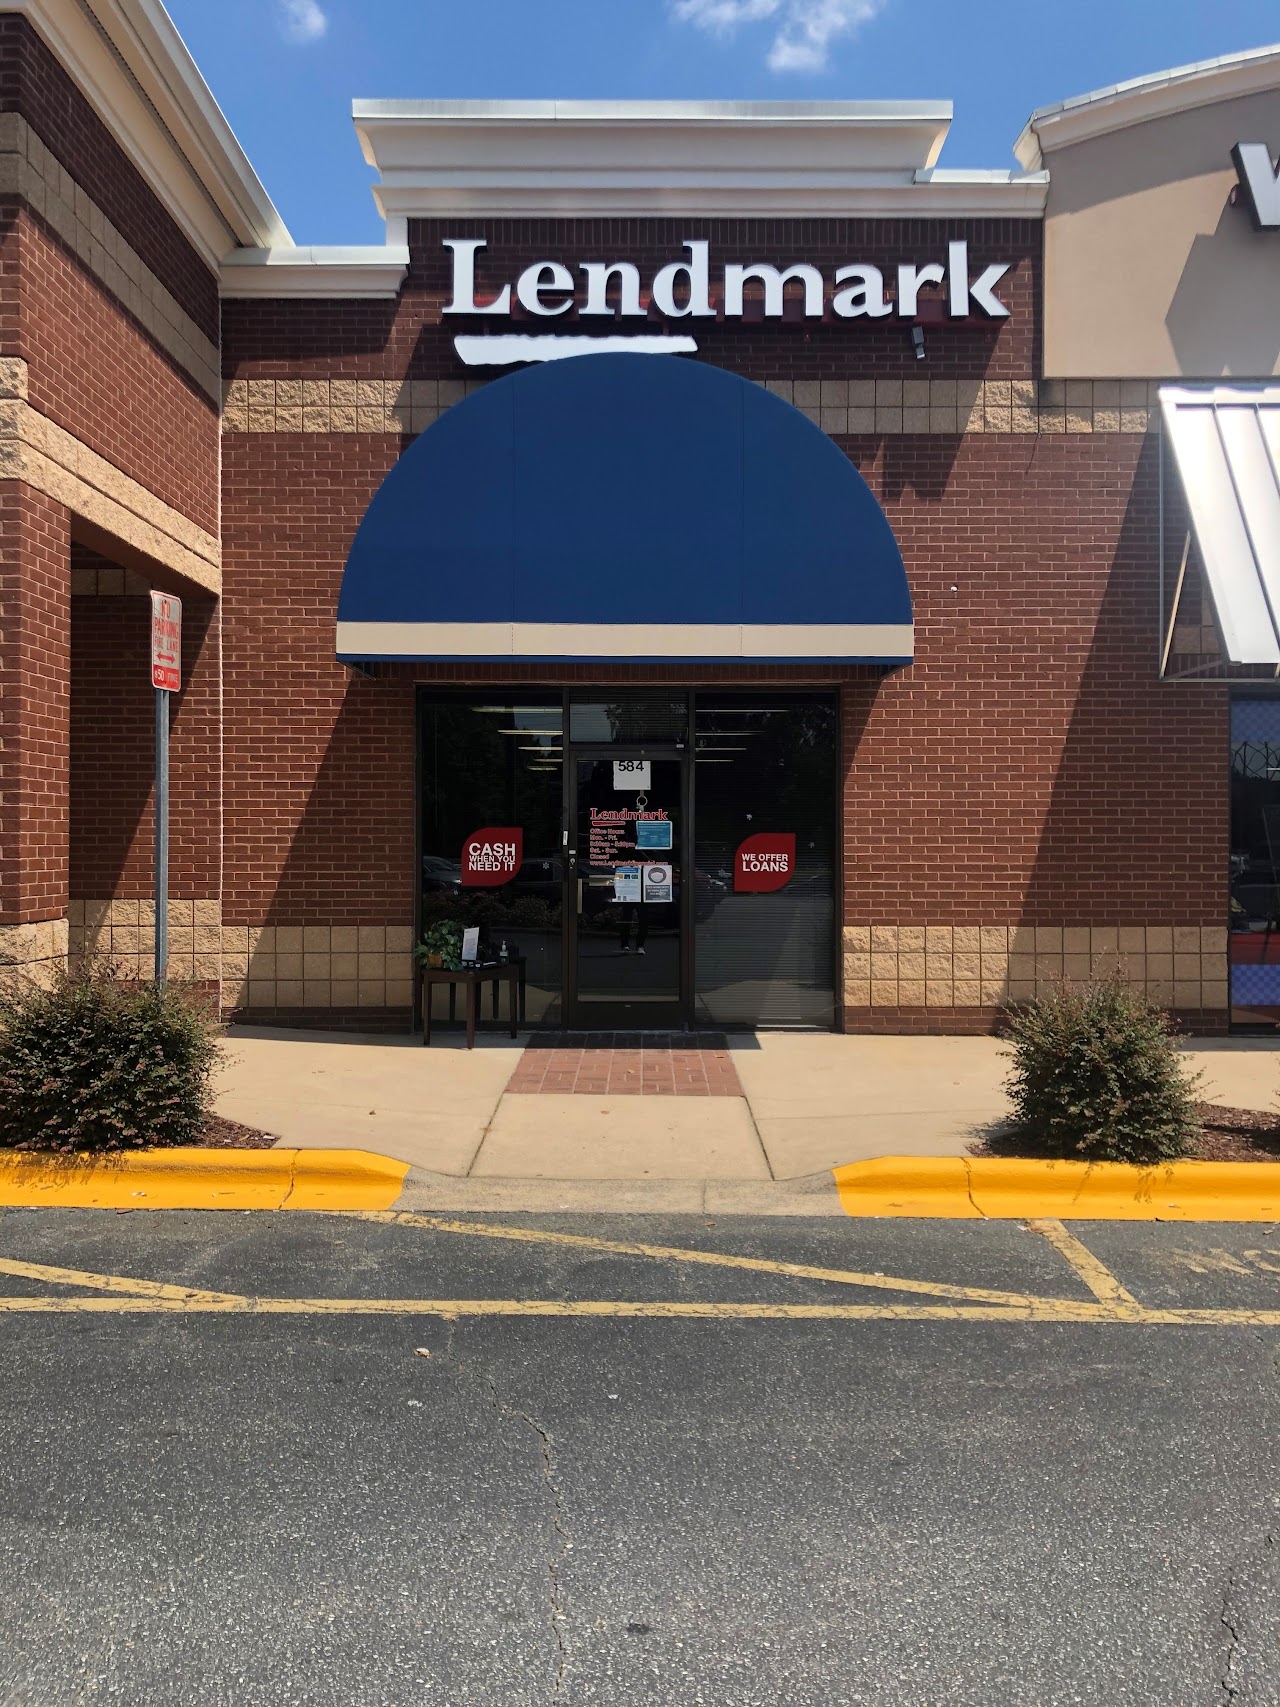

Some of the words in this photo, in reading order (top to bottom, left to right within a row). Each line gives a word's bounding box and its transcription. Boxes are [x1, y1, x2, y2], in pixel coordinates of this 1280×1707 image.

[442, 239, 1012, 319] Lendmark
[161, 600, 171, 619] NO
[154, 617, 179, 639] PARKING
[166, 638, 179, 653] LANE
[154, 669, 165, 682] $50
[618, 760, 645, 772] 584
[590, 808, 668, 820] Lendmark
[469, 843, 515, 856] CASH
[741, 853, 756, 861] WE
[759, 853, 788, 861] OFFER
[469, 862, 501, 871] NEED
[504, 862, 515, 871] IT
[743, 861, 788, 872] LOANS
